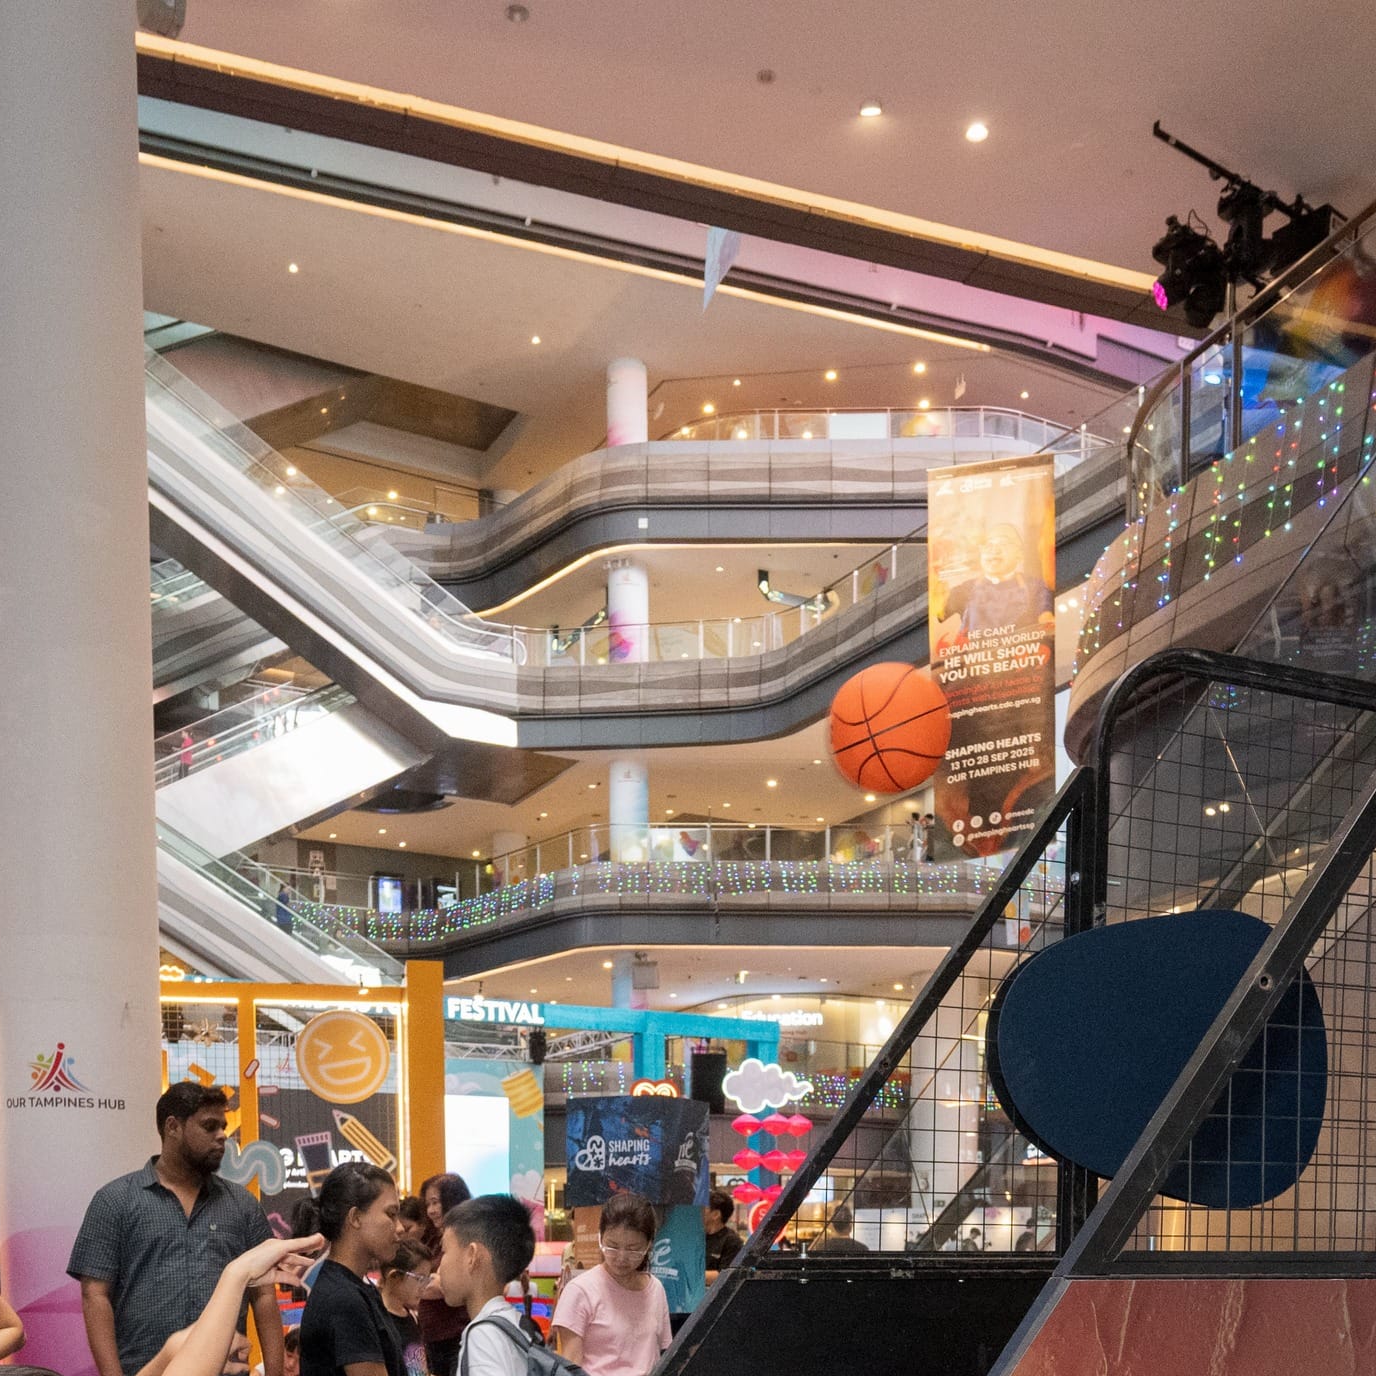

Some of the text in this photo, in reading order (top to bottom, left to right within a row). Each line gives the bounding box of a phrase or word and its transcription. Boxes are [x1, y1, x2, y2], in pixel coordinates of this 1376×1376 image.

[940, 630, 1046, 657] EXPLAIN HIS WORLD?
[968, 624, 1016, 639] HE CAN'T
[944, 642, 1040, 669] HE WILL SHOW
[940, 655, 1046, 683] YOU ITS BEAUTY
[945, 732, 1042, 760] SHAPING HEARTS
[950, 747, 1035, 771] 13 TO 28 SEP 2025
[947, 758, 1040, 784] OUR TAMPINES HUB
[447, 997, 545, 1025] FESTIVAL
[6, 1097, 126, 1110] OUR TAMPINES HUB
[608, 1139, 650, 1153] SHAPING
[608, 1152, 652, 1166] hearts
